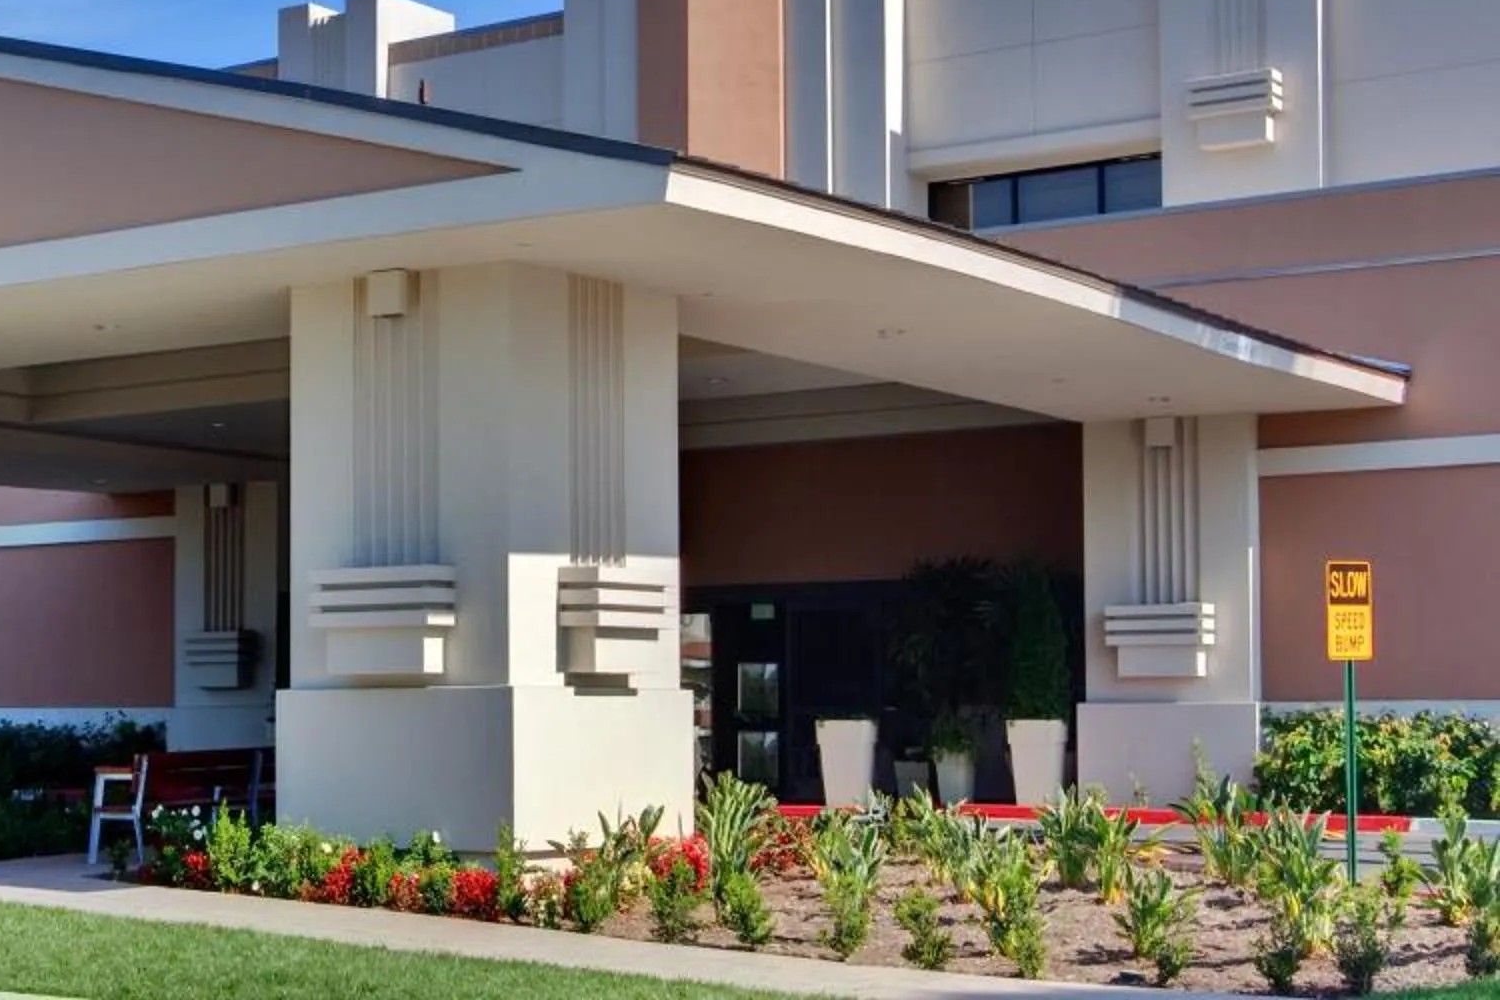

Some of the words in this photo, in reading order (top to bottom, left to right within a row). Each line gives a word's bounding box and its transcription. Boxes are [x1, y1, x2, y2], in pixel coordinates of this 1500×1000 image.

[1331, 571, 1367, 598] SLOW
[1334, 612, 1365, 630] SPEED
[1335, 634, 1365, 653] BUMP
